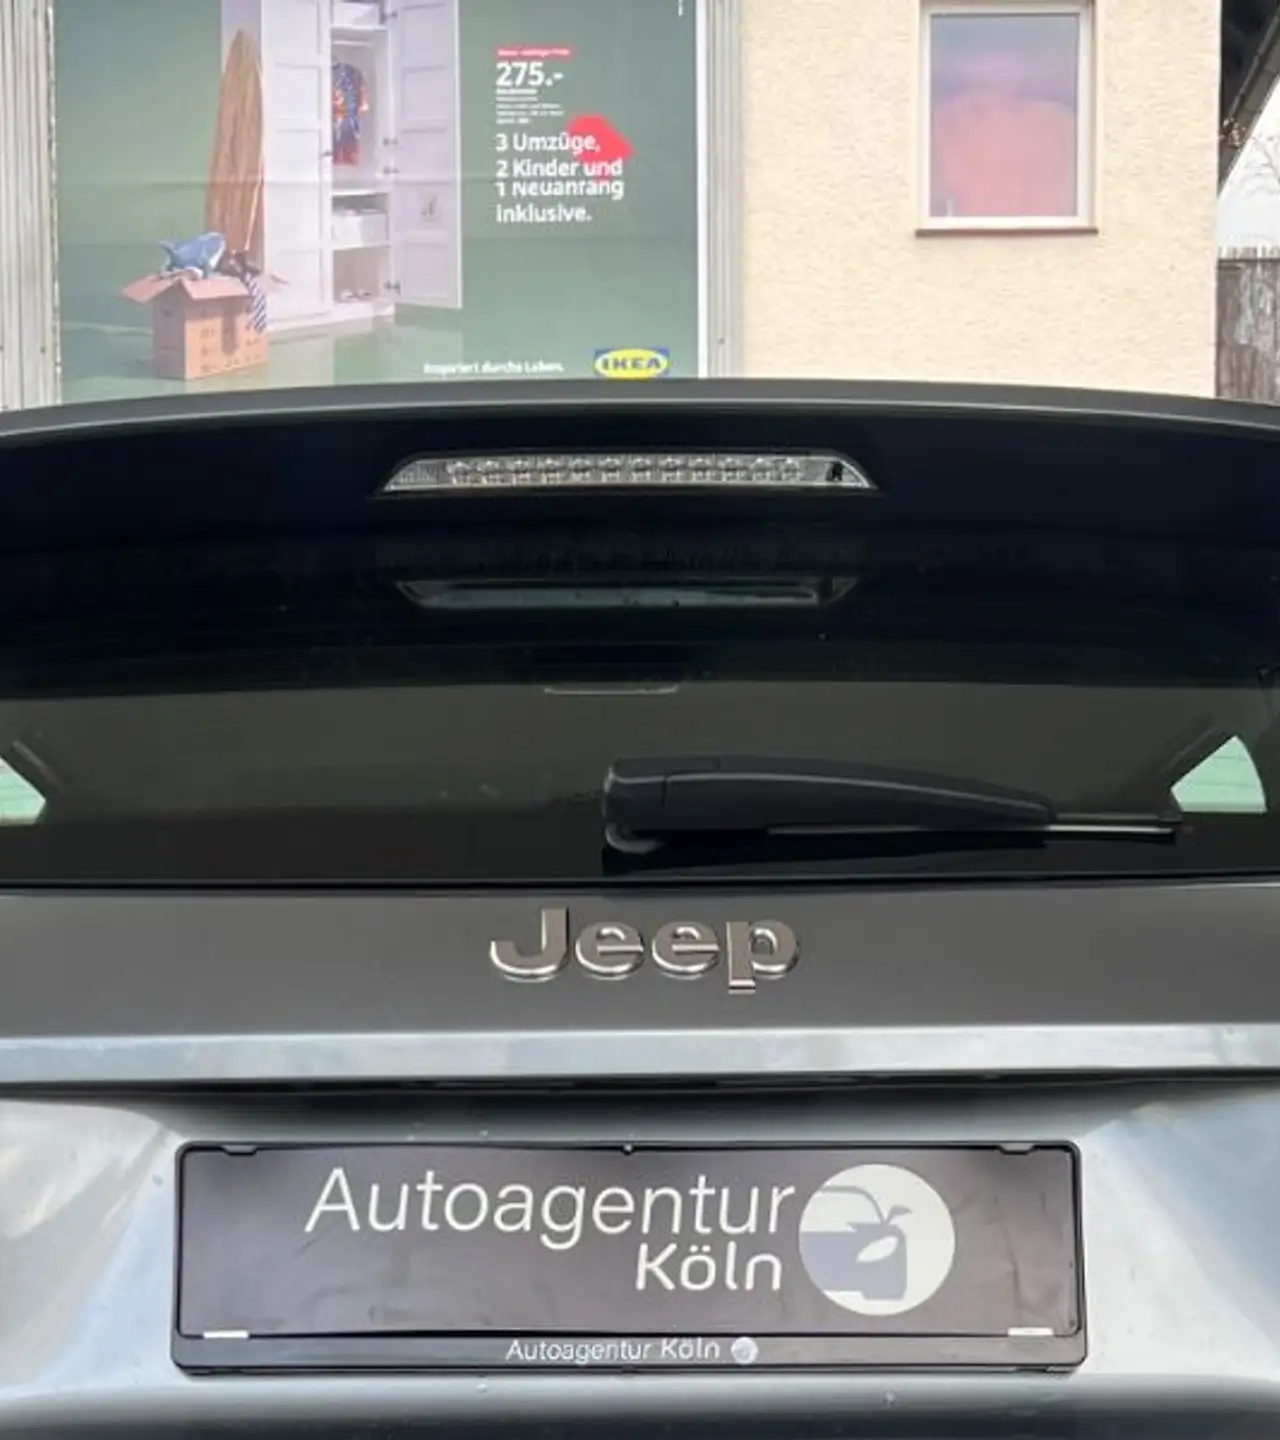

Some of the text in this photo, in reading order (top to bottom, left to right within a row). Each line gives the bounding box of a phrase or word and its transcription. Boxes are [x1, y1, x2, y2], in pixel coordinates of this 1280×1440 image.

[496, 132, 601, 156] 3 Umzüge,
[496, 157, 623, 178] 2 Kinder und
[496, 203, 592, 222] inklusive.
[602, 356, 661, 371] IKEA
[490, 907, 801, 994] Jeep
[303, 1167, 796, 1251] Autoagentur
[635, 1240, 783, 1292] Köln
[505, 1337, 721, 1366] Autoagentur Köln
